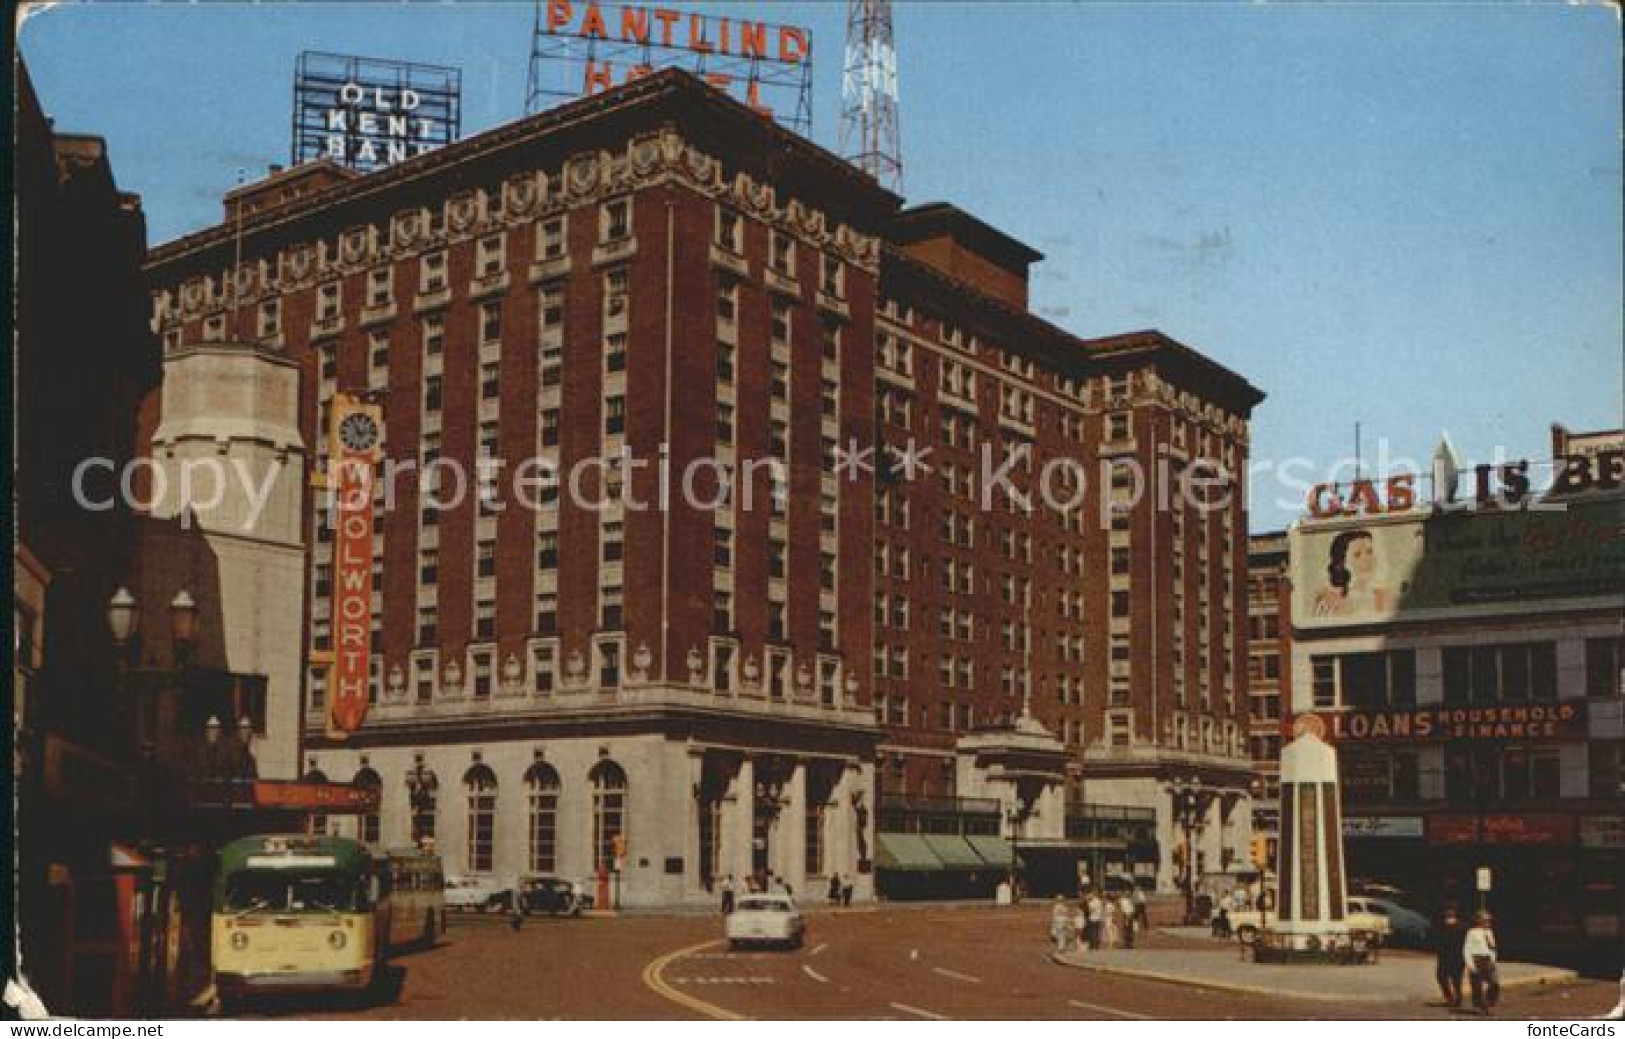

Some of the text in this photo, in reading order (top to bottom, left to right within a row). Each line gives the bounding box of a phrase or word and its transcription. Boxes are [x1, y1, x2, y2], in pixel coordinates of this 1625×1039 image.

[547, 0, 807, 63] PANTLIND
[340, 83, 420, 111] OLD
[328, 108, 434, 137] KENT
[1307, 473, 1416, 518] GAS
[1475, 459, 1529, 502] IS
[340, 461, 370, 697] WOOLWORTH
[1333, 711, 1432, 739] LOANS
[1438, 704, 1575, 724] HOUSEHOLD
[1453, 723, 1556, 739] FINANCE
